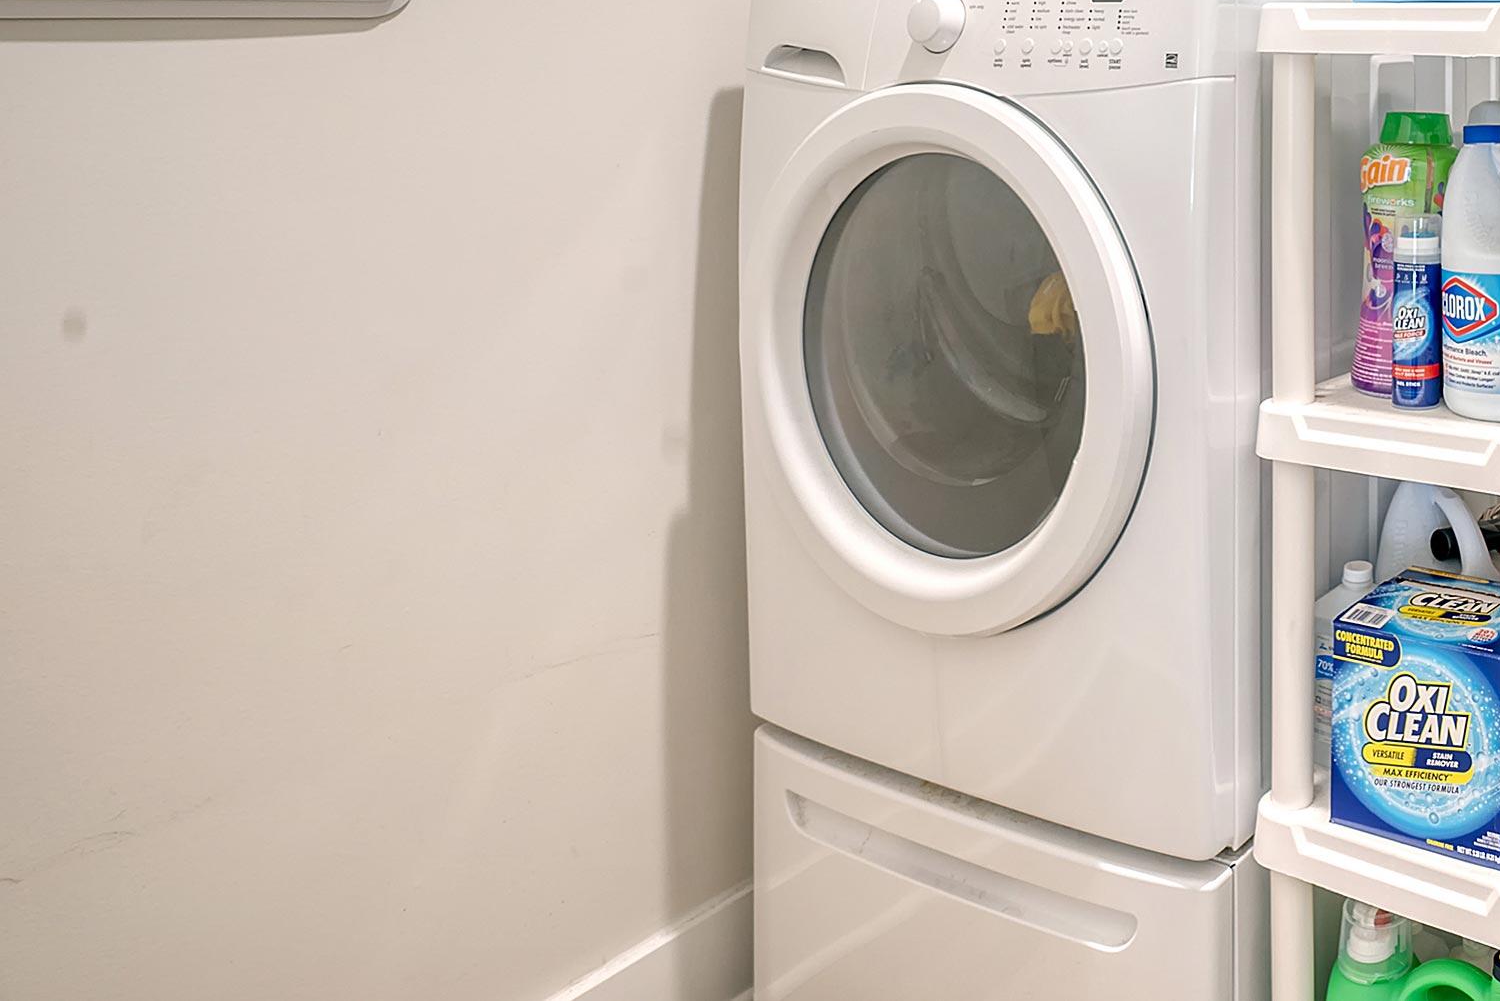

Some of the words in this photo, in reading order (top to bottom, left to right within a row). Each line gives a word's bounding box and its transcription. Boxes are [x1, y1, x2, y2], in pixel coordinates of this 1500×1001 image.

[1398, 306, 1419, 320] OXI
[1394, 317, 1425, 331] CLEAN
[1335, 629, 1394, 652] CONCENTRATED
[1345, 642, 1384, 661] FORMULA
[1317, 658, 1334, 671] 70%
[1389, 674, 1451, 715] OXI
[1365, 701, 1469, 748] CLEAN
[1372, 749, 1405, 761] VERSATILE
[1432, 752, 1453, 761] STAIN
[1426, 759, 1459, 769] REMOVER
[1383, 768, 1403, 777] MAX
[1405, 770, 1450, 782] EFFICIENCY
[1374, 778, 1388, 787] OUR
[1390, 780, 1427, 791] STRONGEST
[1428, 784, 1460, 795] FORMULA
